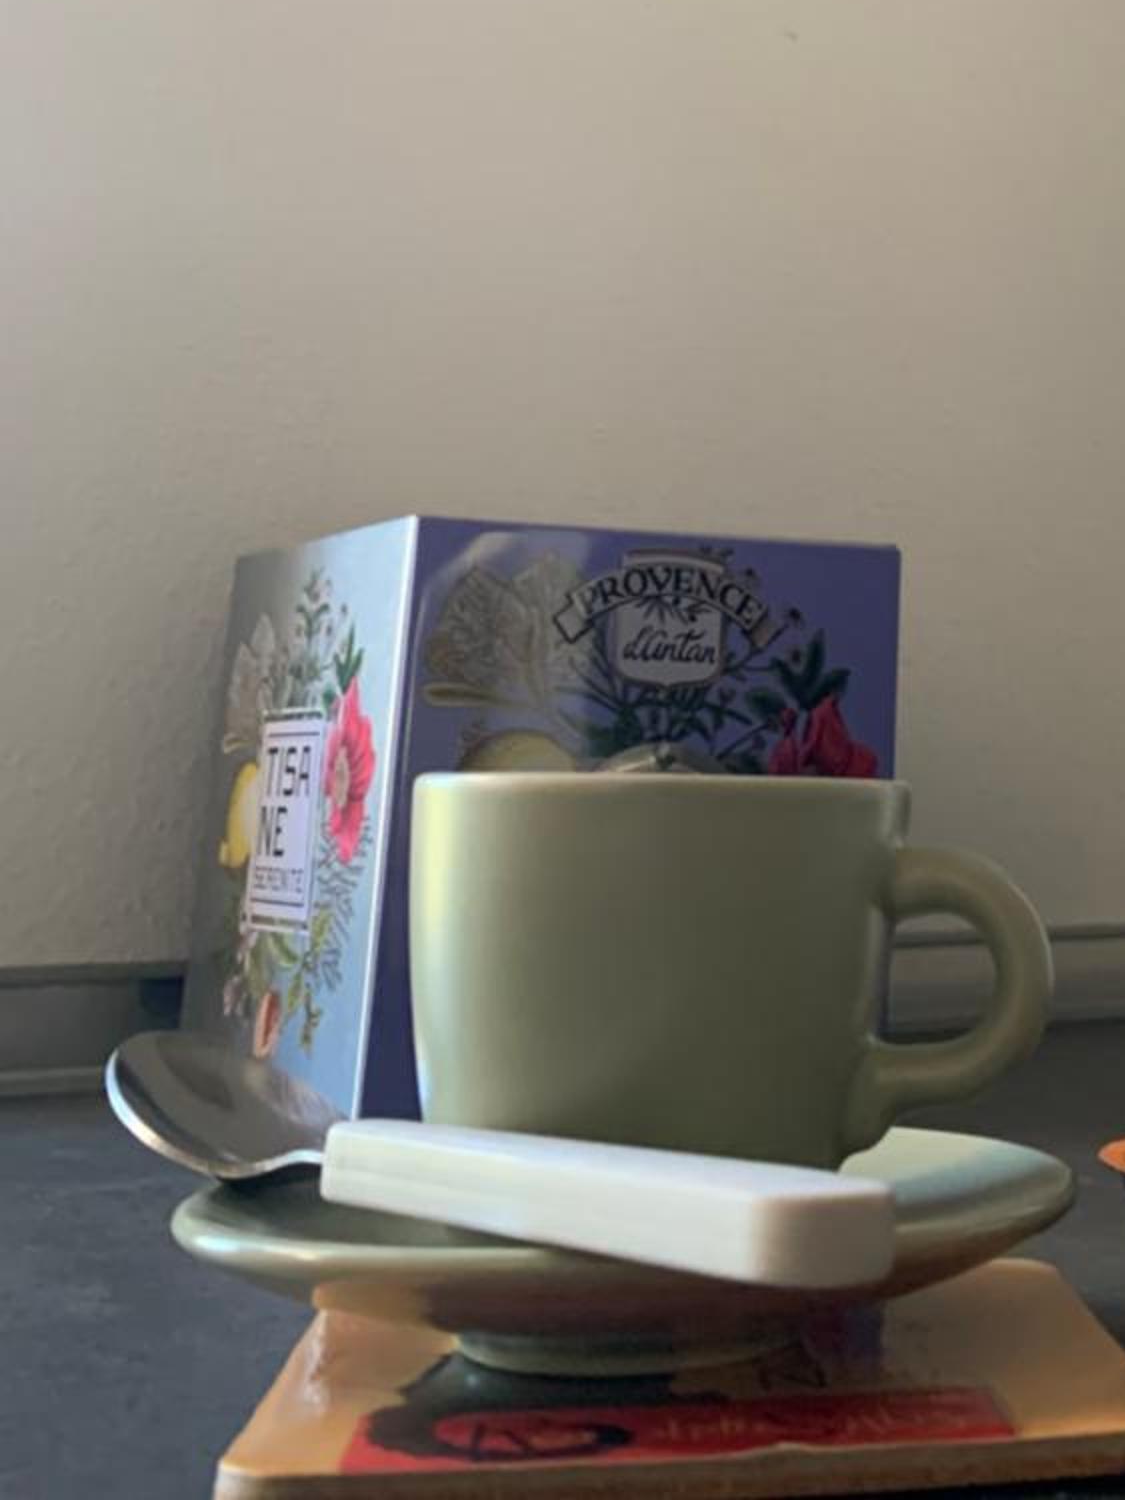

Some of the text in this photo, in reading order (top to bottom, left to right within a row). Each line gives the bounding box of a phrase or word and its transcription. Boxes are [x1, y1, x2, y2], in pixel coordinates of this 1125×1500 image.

[573, 565, 766, 625] PROVENCE
[265, 746, 311, 798] TISA
[256, 804, 288, 858] NE
